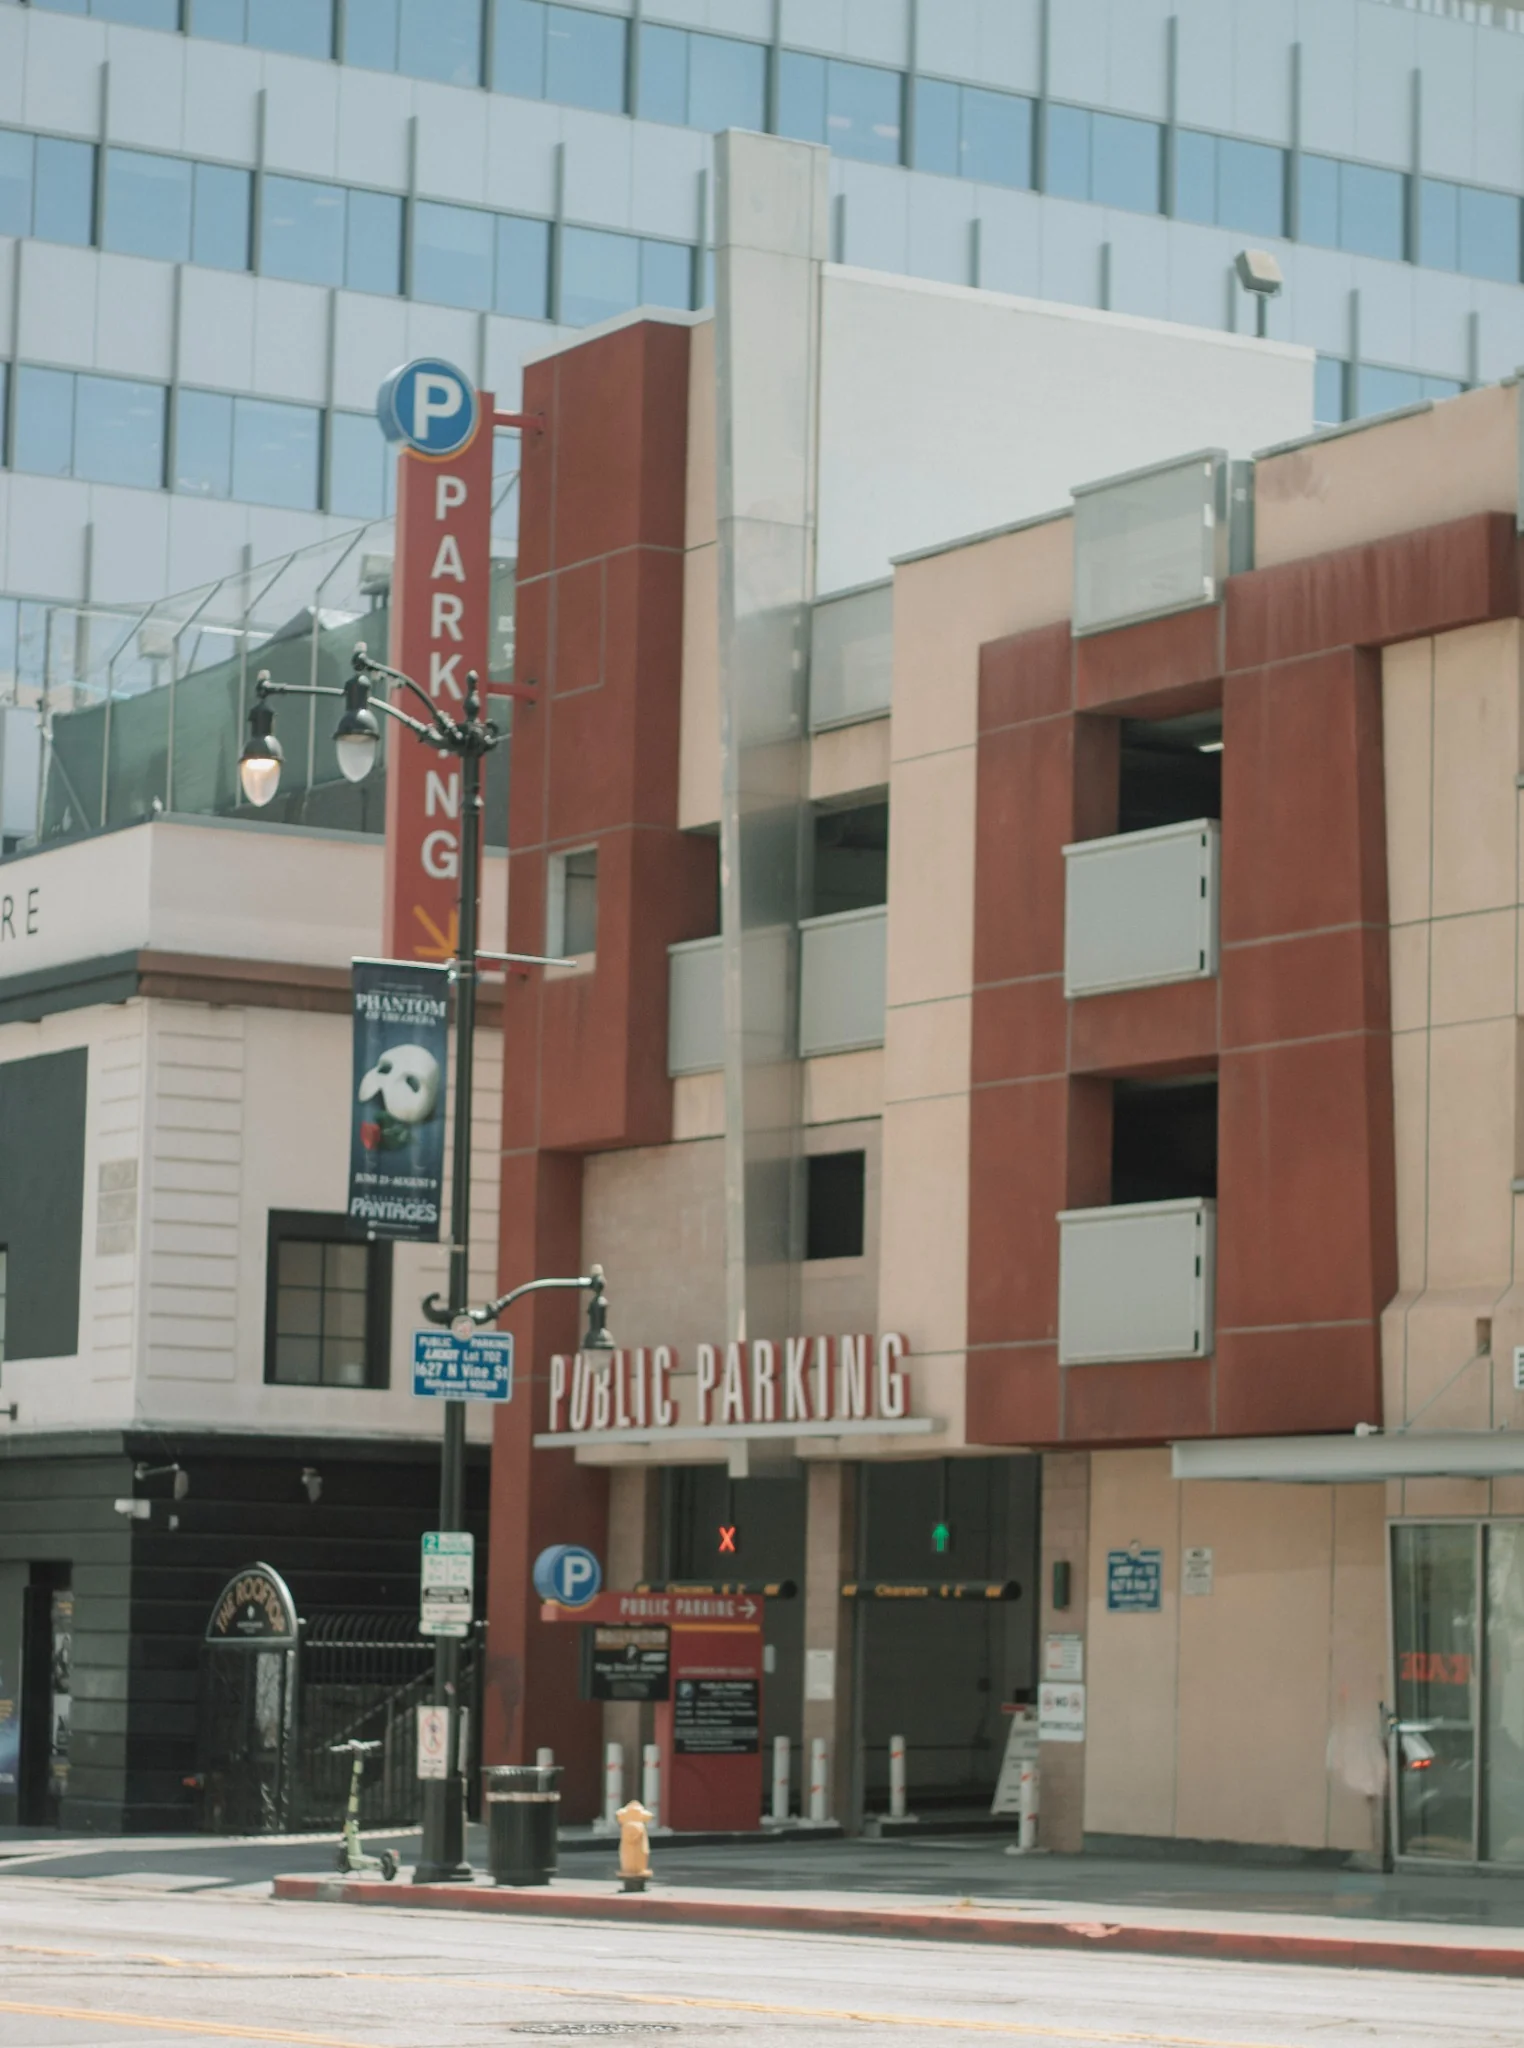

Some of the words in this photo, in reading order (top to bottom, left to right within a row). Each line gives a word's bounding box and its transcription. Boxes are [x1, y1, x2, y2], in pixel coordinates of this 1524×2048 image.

[413, 372, 463, 440] P
[420, 474, 468, 880] PARKNG
[355, 992, 447, 1018] PHANTOM
[350, 1197, 437, 1223] PANTAGES
[461, 1363, 489, 1379] Vine
[549, 1344, 679, 1433] PUBLIC
[697, 1332, 911, 1424] PARKING
[562, 1555, 593, 1597] P
[620, 1598, 670, 1616] PUBLIC
[676, 1600, 736, 1618] PARKING
